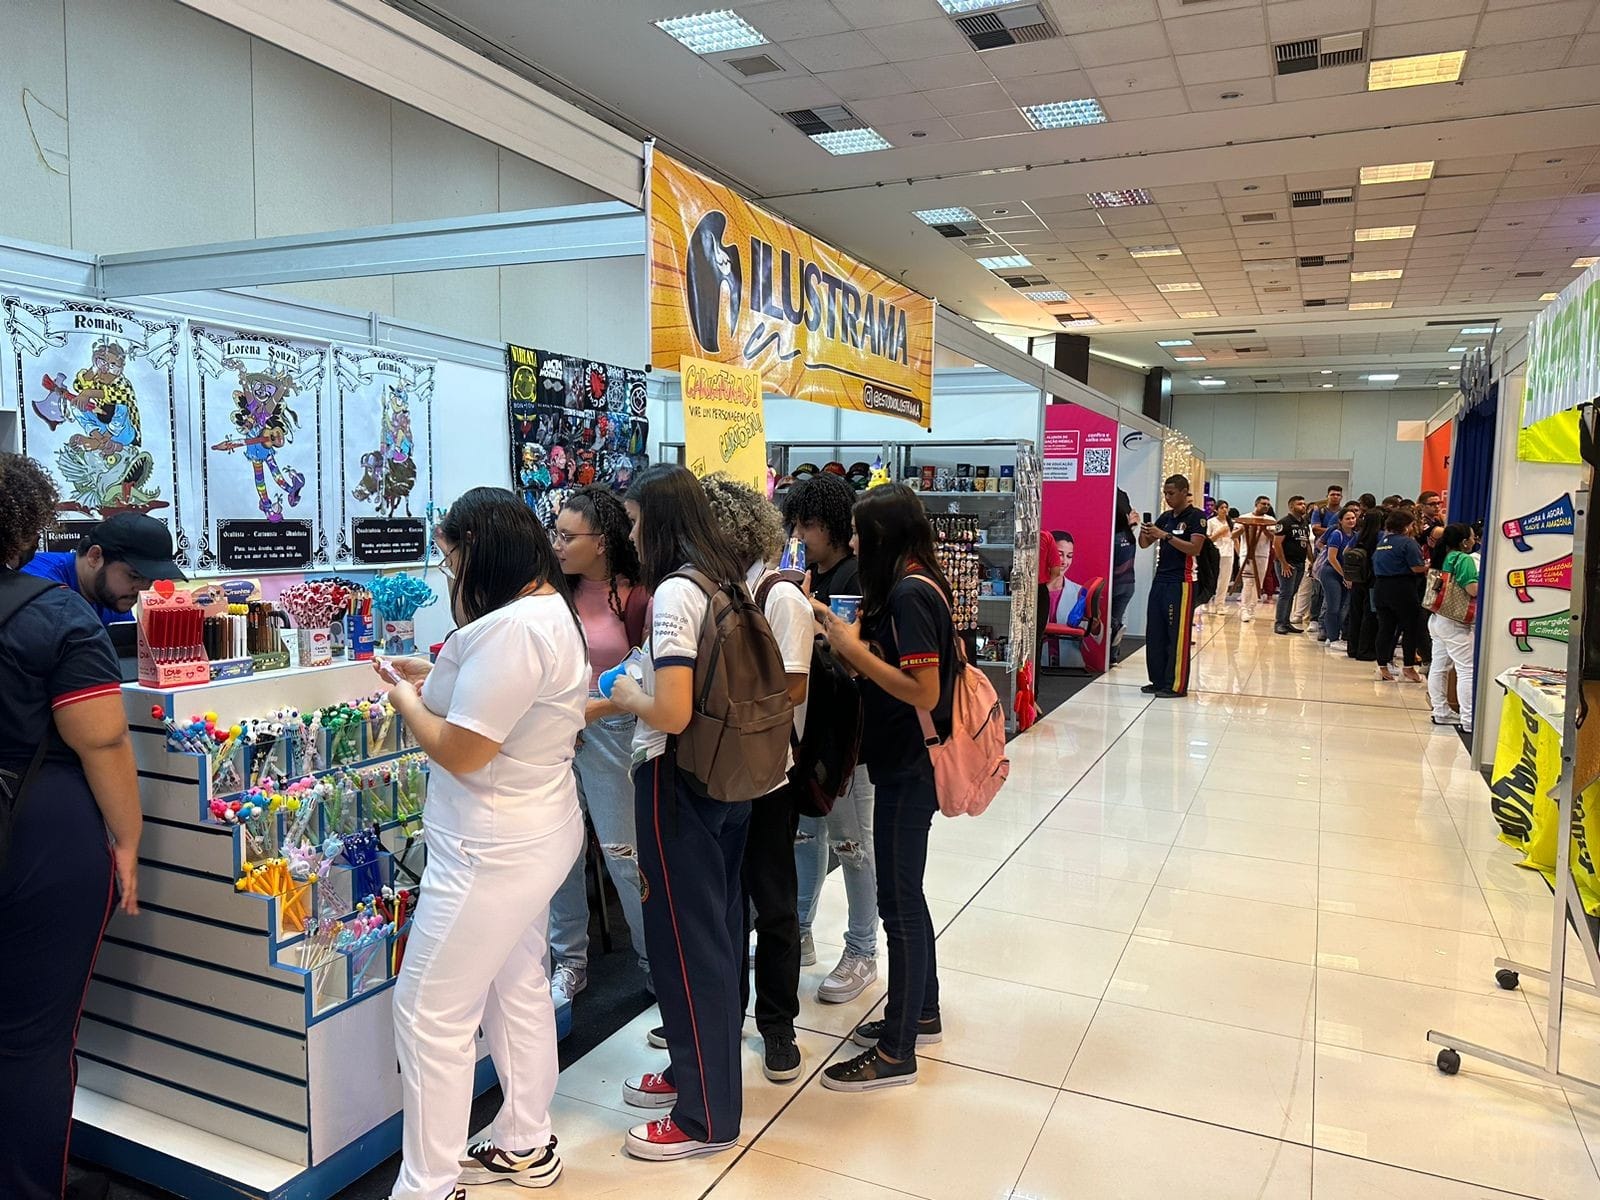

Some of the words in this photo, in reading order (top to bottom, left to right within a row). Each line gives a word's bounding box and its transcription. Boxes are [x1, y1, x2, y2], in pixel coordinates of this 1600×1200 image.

[750, 235, 908, 366] ILUSTRAMA
[74, 314, 124, 334] Romahs
[226, 342, 261, 355] Lorena
[267, 345, 297, 365] Souza
[1530, 616, 1570, 627] Emergênc
[1534, 627, 1569, 636] Climátic
